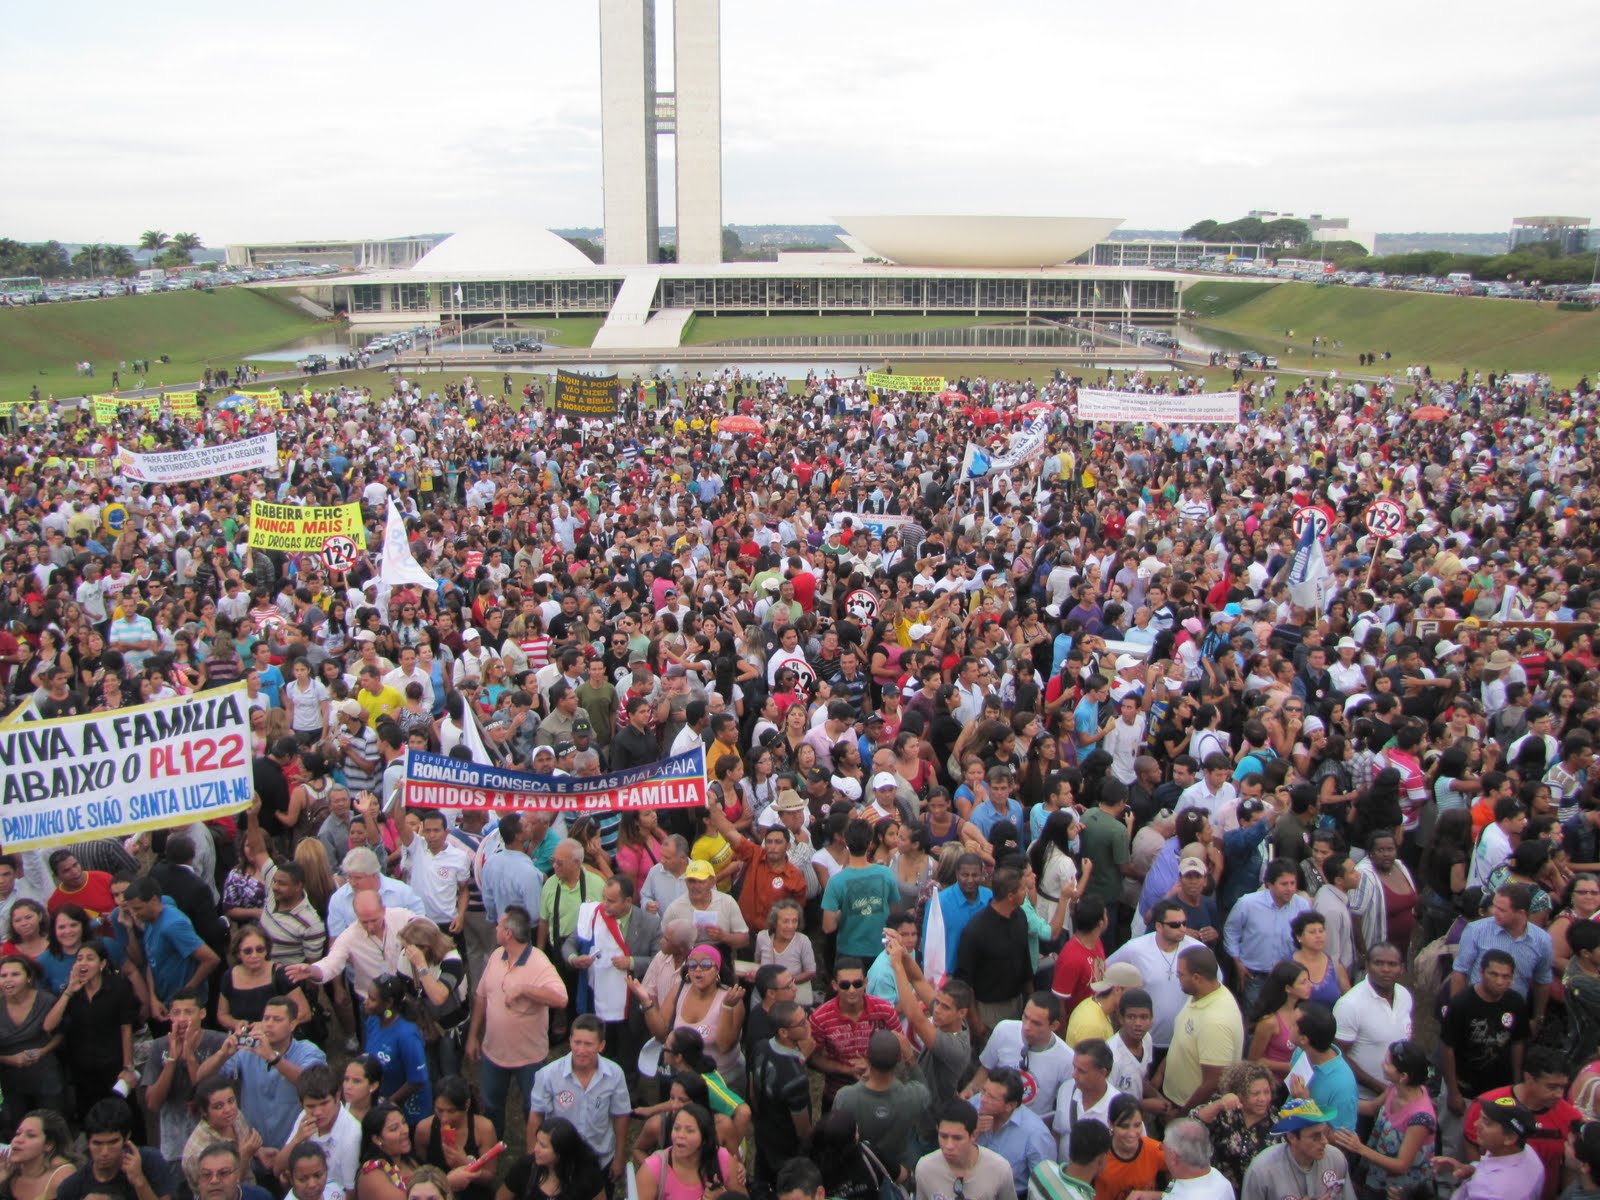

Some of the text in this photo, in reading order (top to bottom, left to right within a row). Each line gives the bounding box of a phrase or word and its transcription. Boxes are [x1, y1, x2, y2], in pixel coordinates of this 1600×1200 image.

[565, 386, 579, 394] VÃO
[591, 379, 619, 388] POUCO
[561, 394, 576, 403] QUE
[564, 403, 616, 412] HOMOFÓBICA
[143, 455, 162, 464] PARA
[163, 452, 194, 463] SERDES
[149, 460, 200, 473] AVENTURADOS
[201, 457, 211, 466] OS
[212, 453, 227, 464] QUE
[255, 503, 303, 520] GABEIRA
[314, 507, 343, 520] FHC
[1368, 509, 1400, 531] 122
[255, 518, 296, 534] NUNCA
[302, 519, 343, 534] MAIS
[1296, 517, 1327, 538] 12
[253, 533, 265, 545] AS
[268, 535, 301, 549] DROGAS
[323, 543, 355, 565] 122
[792, 662, 799, 670] PL
[0, 694, 244, 767] VIVA A FAMÍLIA
[3, 734, 245, 805] ABAIXO O PL122
[414, 754, 469, 770] DEPUTADO
[413, 758, 697, 793] RONALDO FONSECA E SILAS MALAFAIA
[410, 781, 699, 808] UNIDOS A FAVOR DA FAMÍLIA
[2, 807, 64, 842] PAULINHO
[67, 806, 83, 831] DE
[87, 796, 123, 829] SIÃO
[129, 788, 180, 820] SANTA
